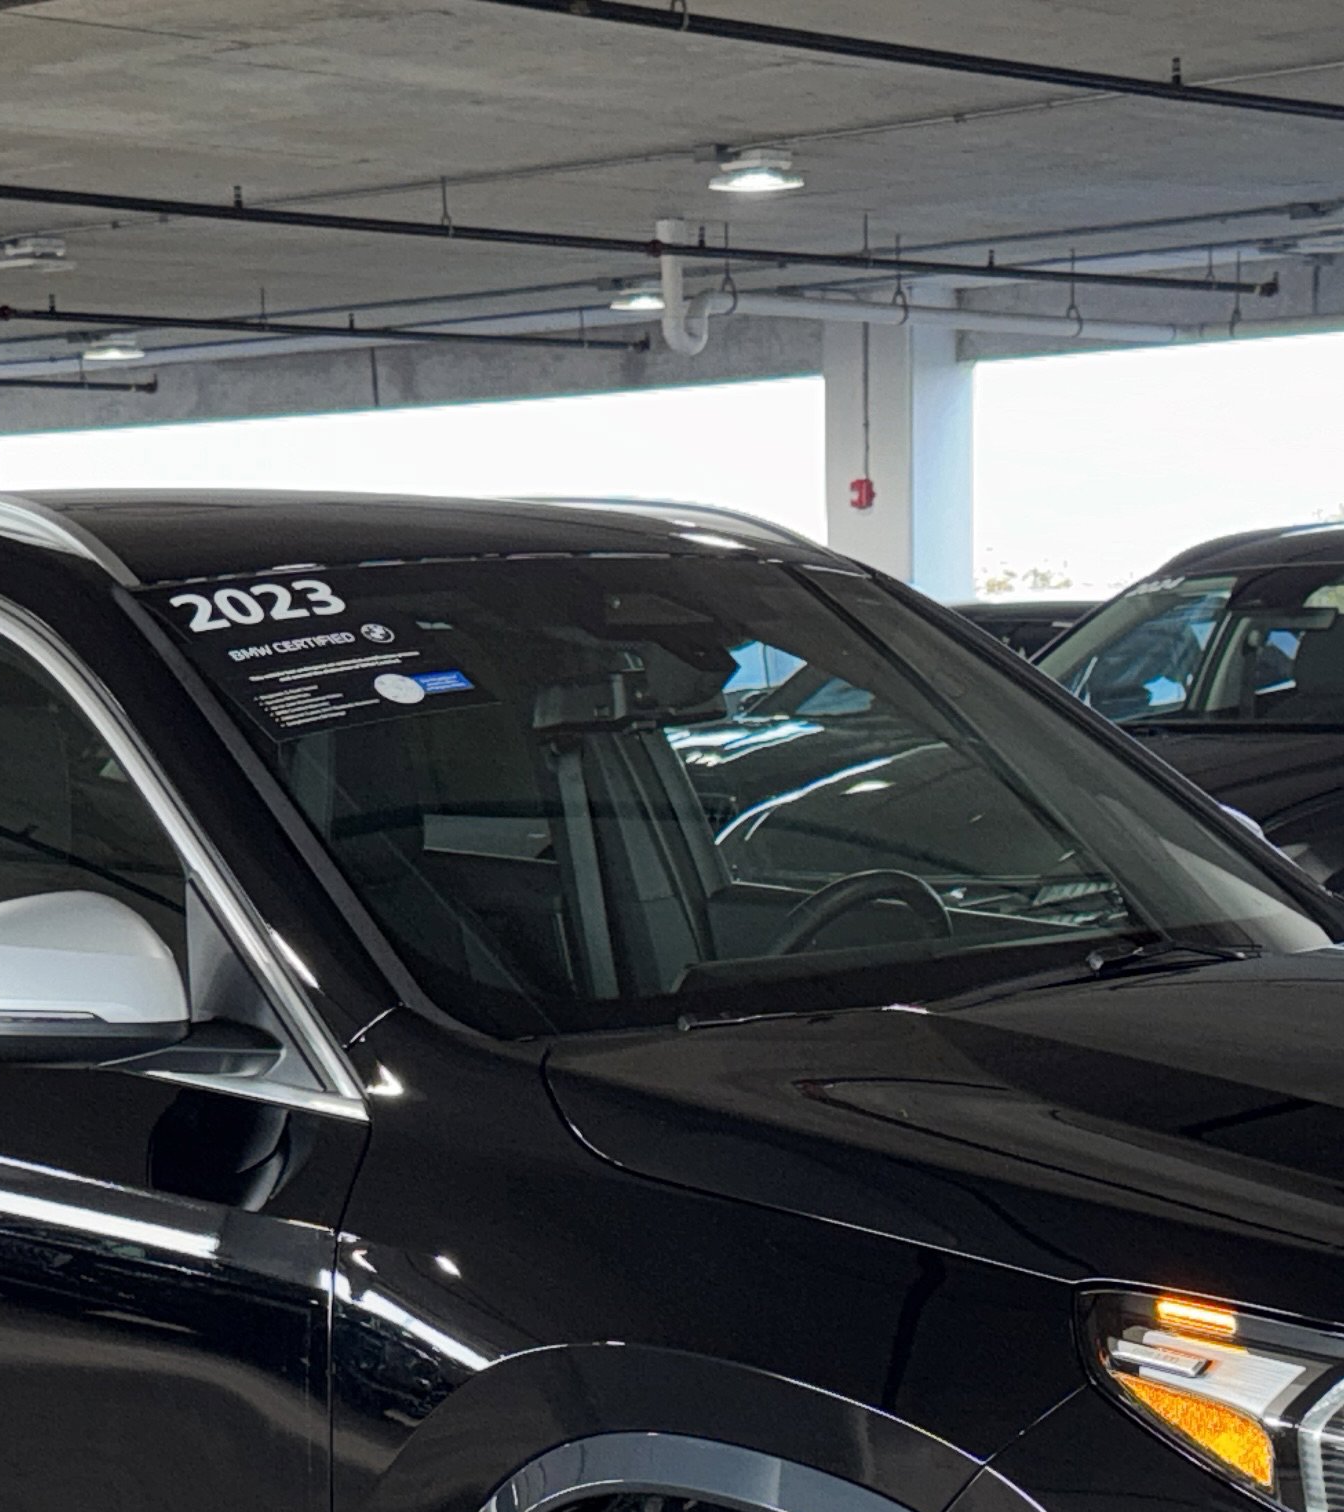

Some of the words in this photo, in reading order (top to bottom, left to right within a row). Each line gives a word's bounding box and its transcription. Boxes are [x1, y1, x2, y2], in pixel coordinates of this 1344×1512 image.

[170, 580, 346, 633] 2023
[228, 643, 273, 662] BMW
[272, 632, 356, 654] CERTIFIED
